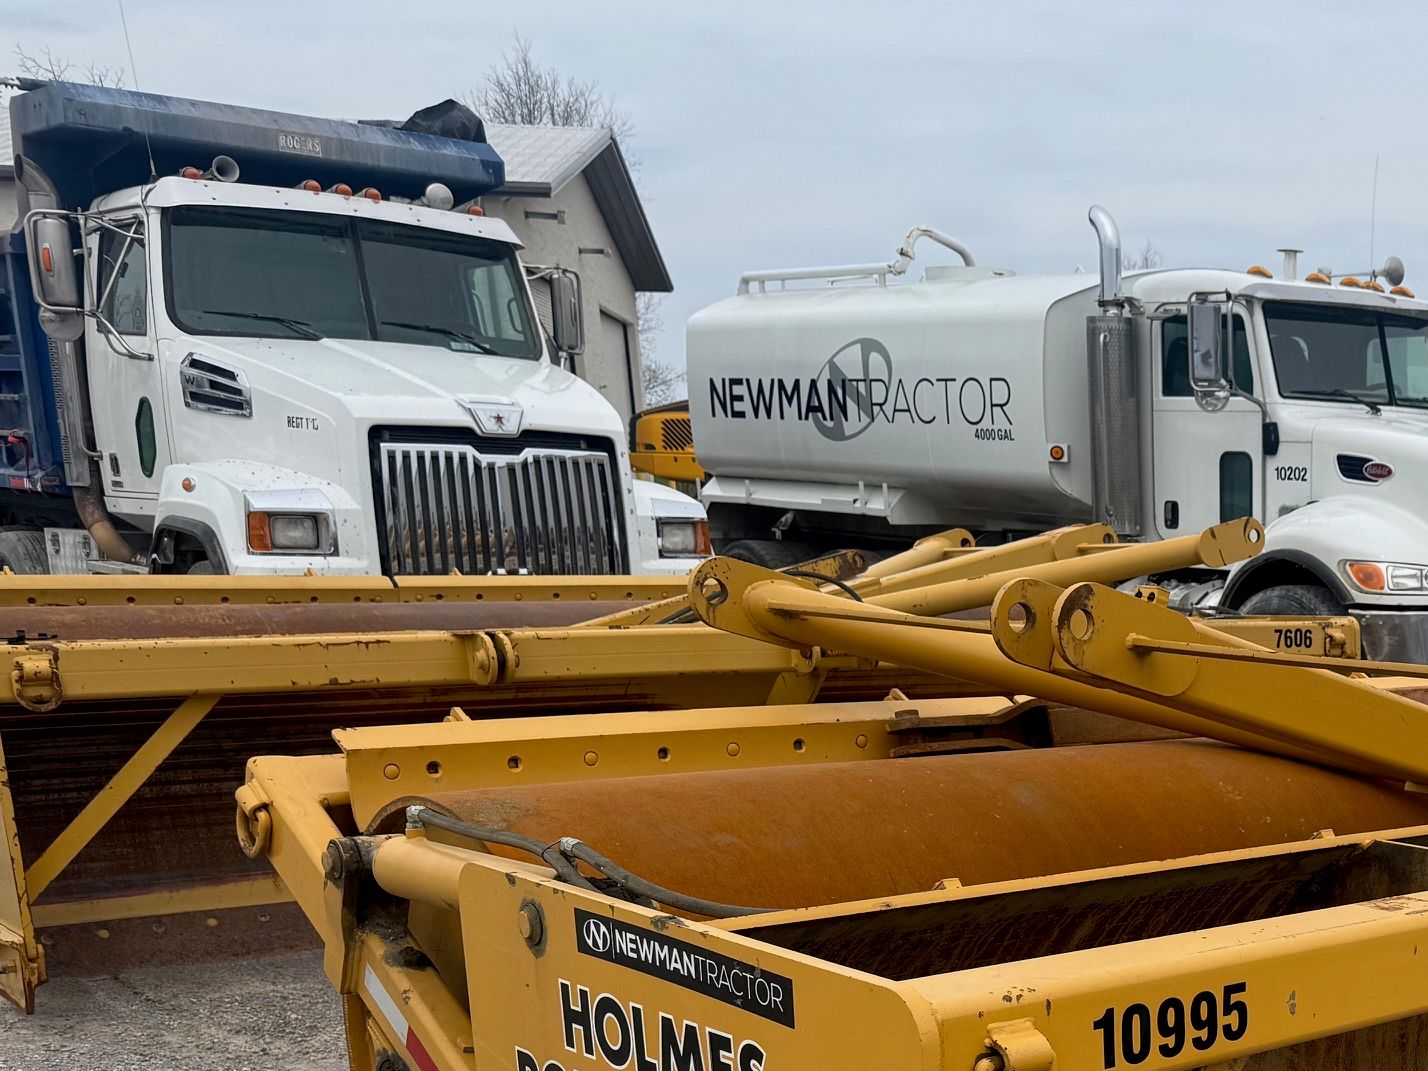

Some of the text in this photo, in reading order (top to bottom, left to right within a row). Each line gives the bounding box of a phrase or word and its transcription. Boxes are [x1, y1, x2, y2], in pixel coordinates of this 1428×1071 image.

[709, 377, 1013, 425] NEWMANTRACTOR
[974, 428, 1015, 441] 4000 GAL
[1275, 466, 1308, 482] 10202
[1274, 628, 1313, 648] 7606
[615, 929, 784, 1012] NEWMANTRACTOR
[1092, 981, 1248, 1070] 10995
